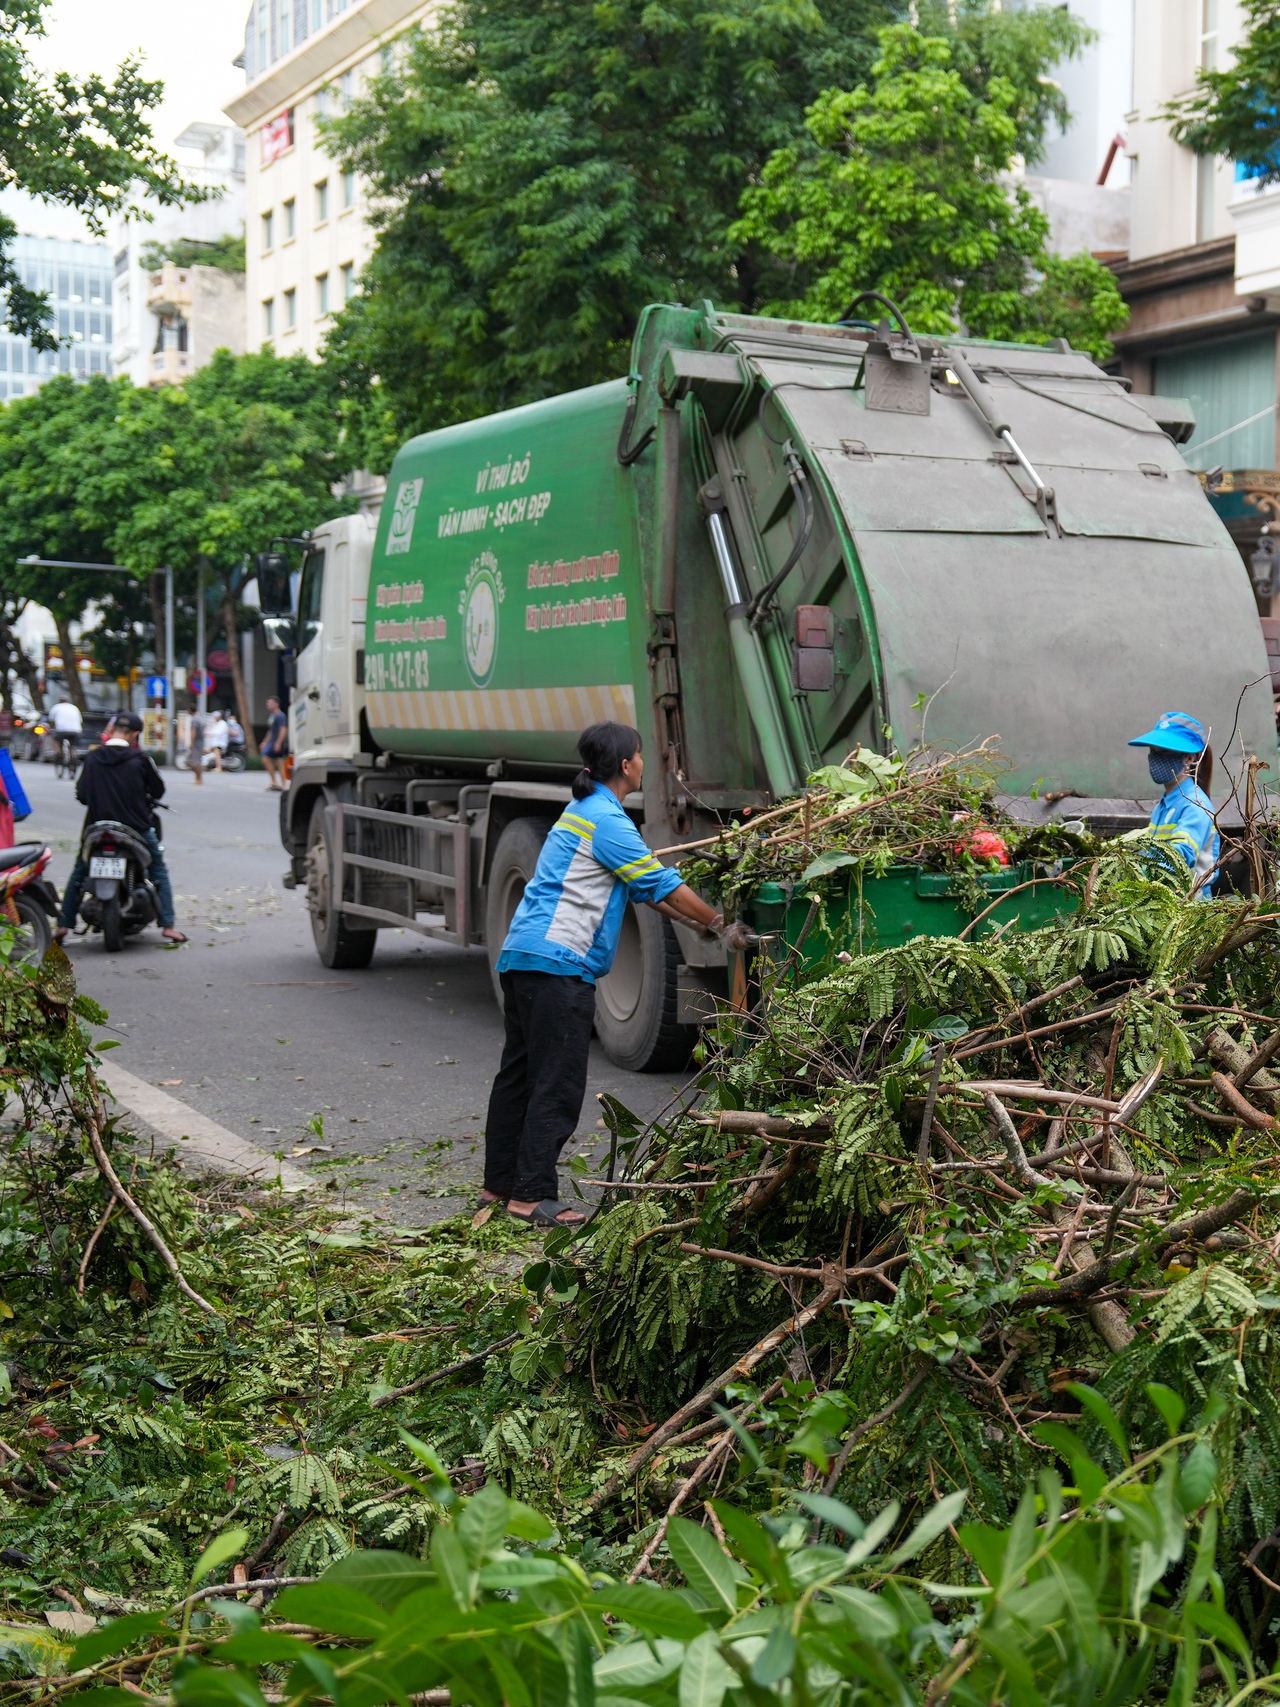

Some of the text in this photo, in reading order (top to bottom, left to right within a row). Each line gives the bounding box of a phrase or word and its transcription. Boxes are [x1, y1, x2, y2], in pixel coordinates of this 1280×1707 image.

[475, 461, 491, 494] VÌ
[488, 453, 513, 491] THỦ
[438, 506, 462, 538] VĂN
[459, 505, 490, 535] MINH
[493, 496, 528, 533] SẠCH
[526, 491, 552, 526] ĐẸP
